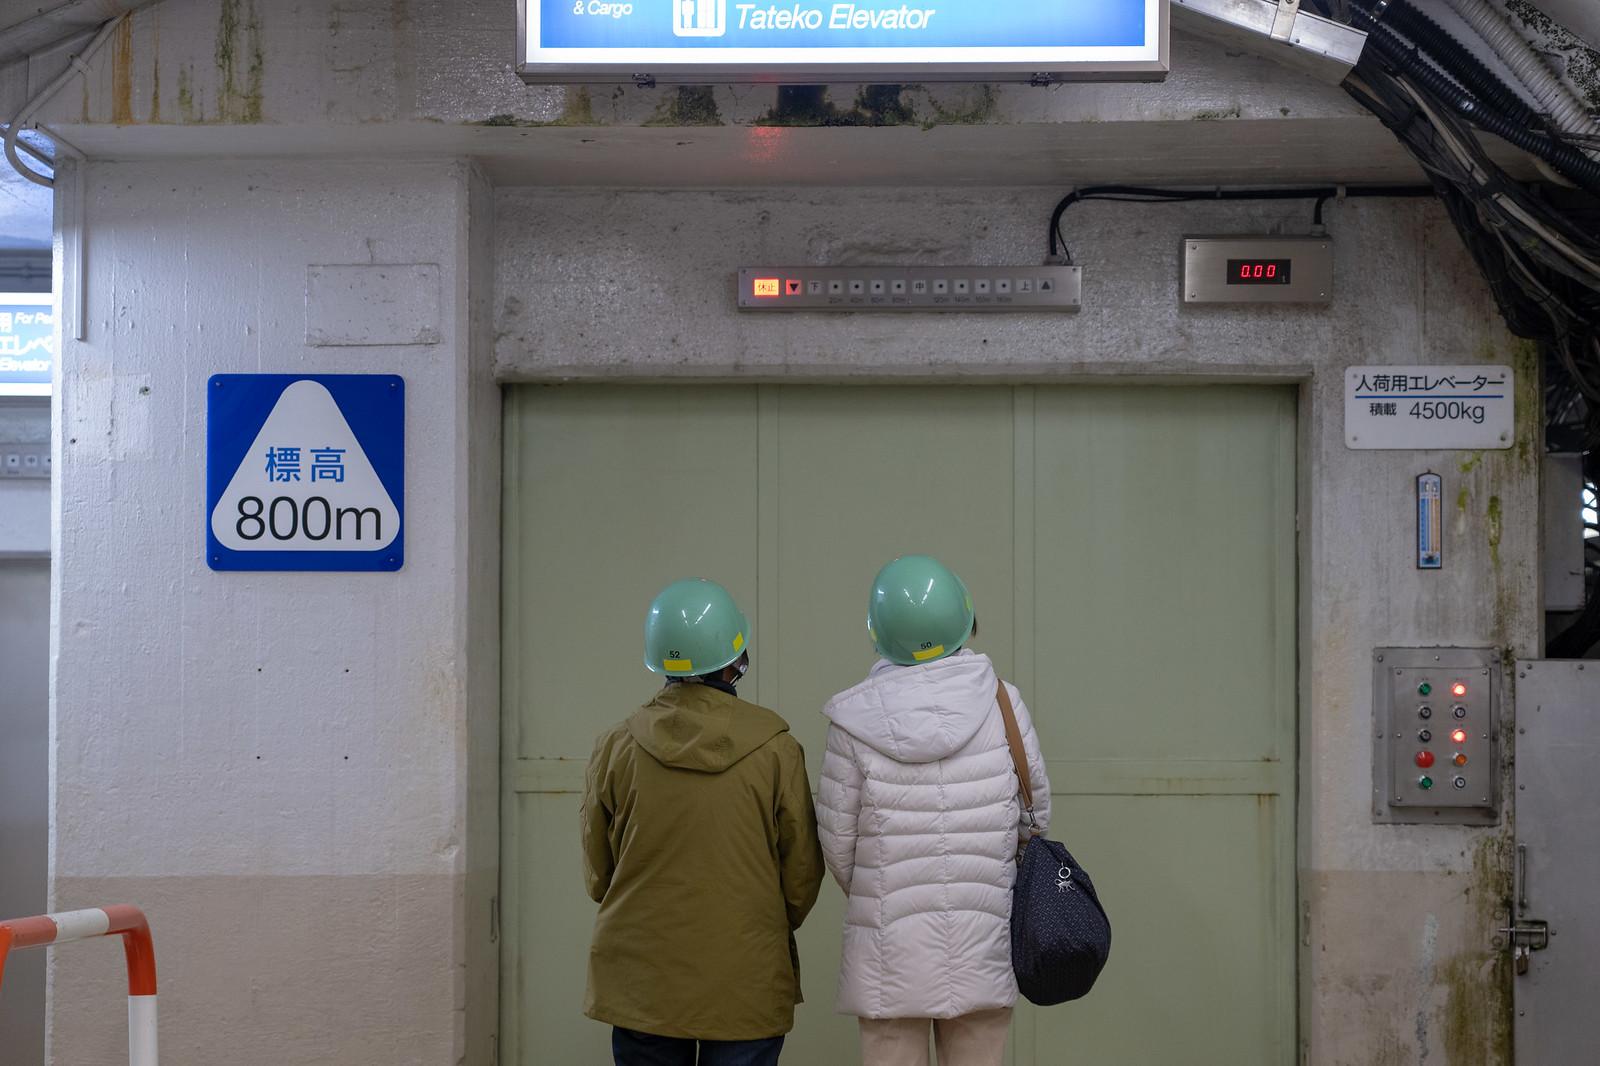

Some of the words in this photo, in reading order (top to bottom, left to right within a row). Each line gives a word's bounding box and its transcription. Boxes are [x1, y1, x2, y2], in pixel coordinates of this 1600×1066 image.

[573, 0, 585, 15] &
[587, 0, 633, 18] Cargo
[735, 4, 823, 29] Tateko
[828, 4, 936, 29] Elevator
[1240, 264, 1277, 278] 0.00
[915, 281, 925, 292] 中
[1021, 281, 1030, 291] 上
[14, 312, 34, 324] For
[1355, 374, 1504, 393] 人荷用エレベーター
[1369, 402, 1397, 417] 積載
[1409, 401, 1485, 424] 4500kg
[264, 446, 346, 483] 標高
[235, 496, 382, 541] 800m
[920, 641, 933, 650] 50
[669, 650, 681, 659] 52
